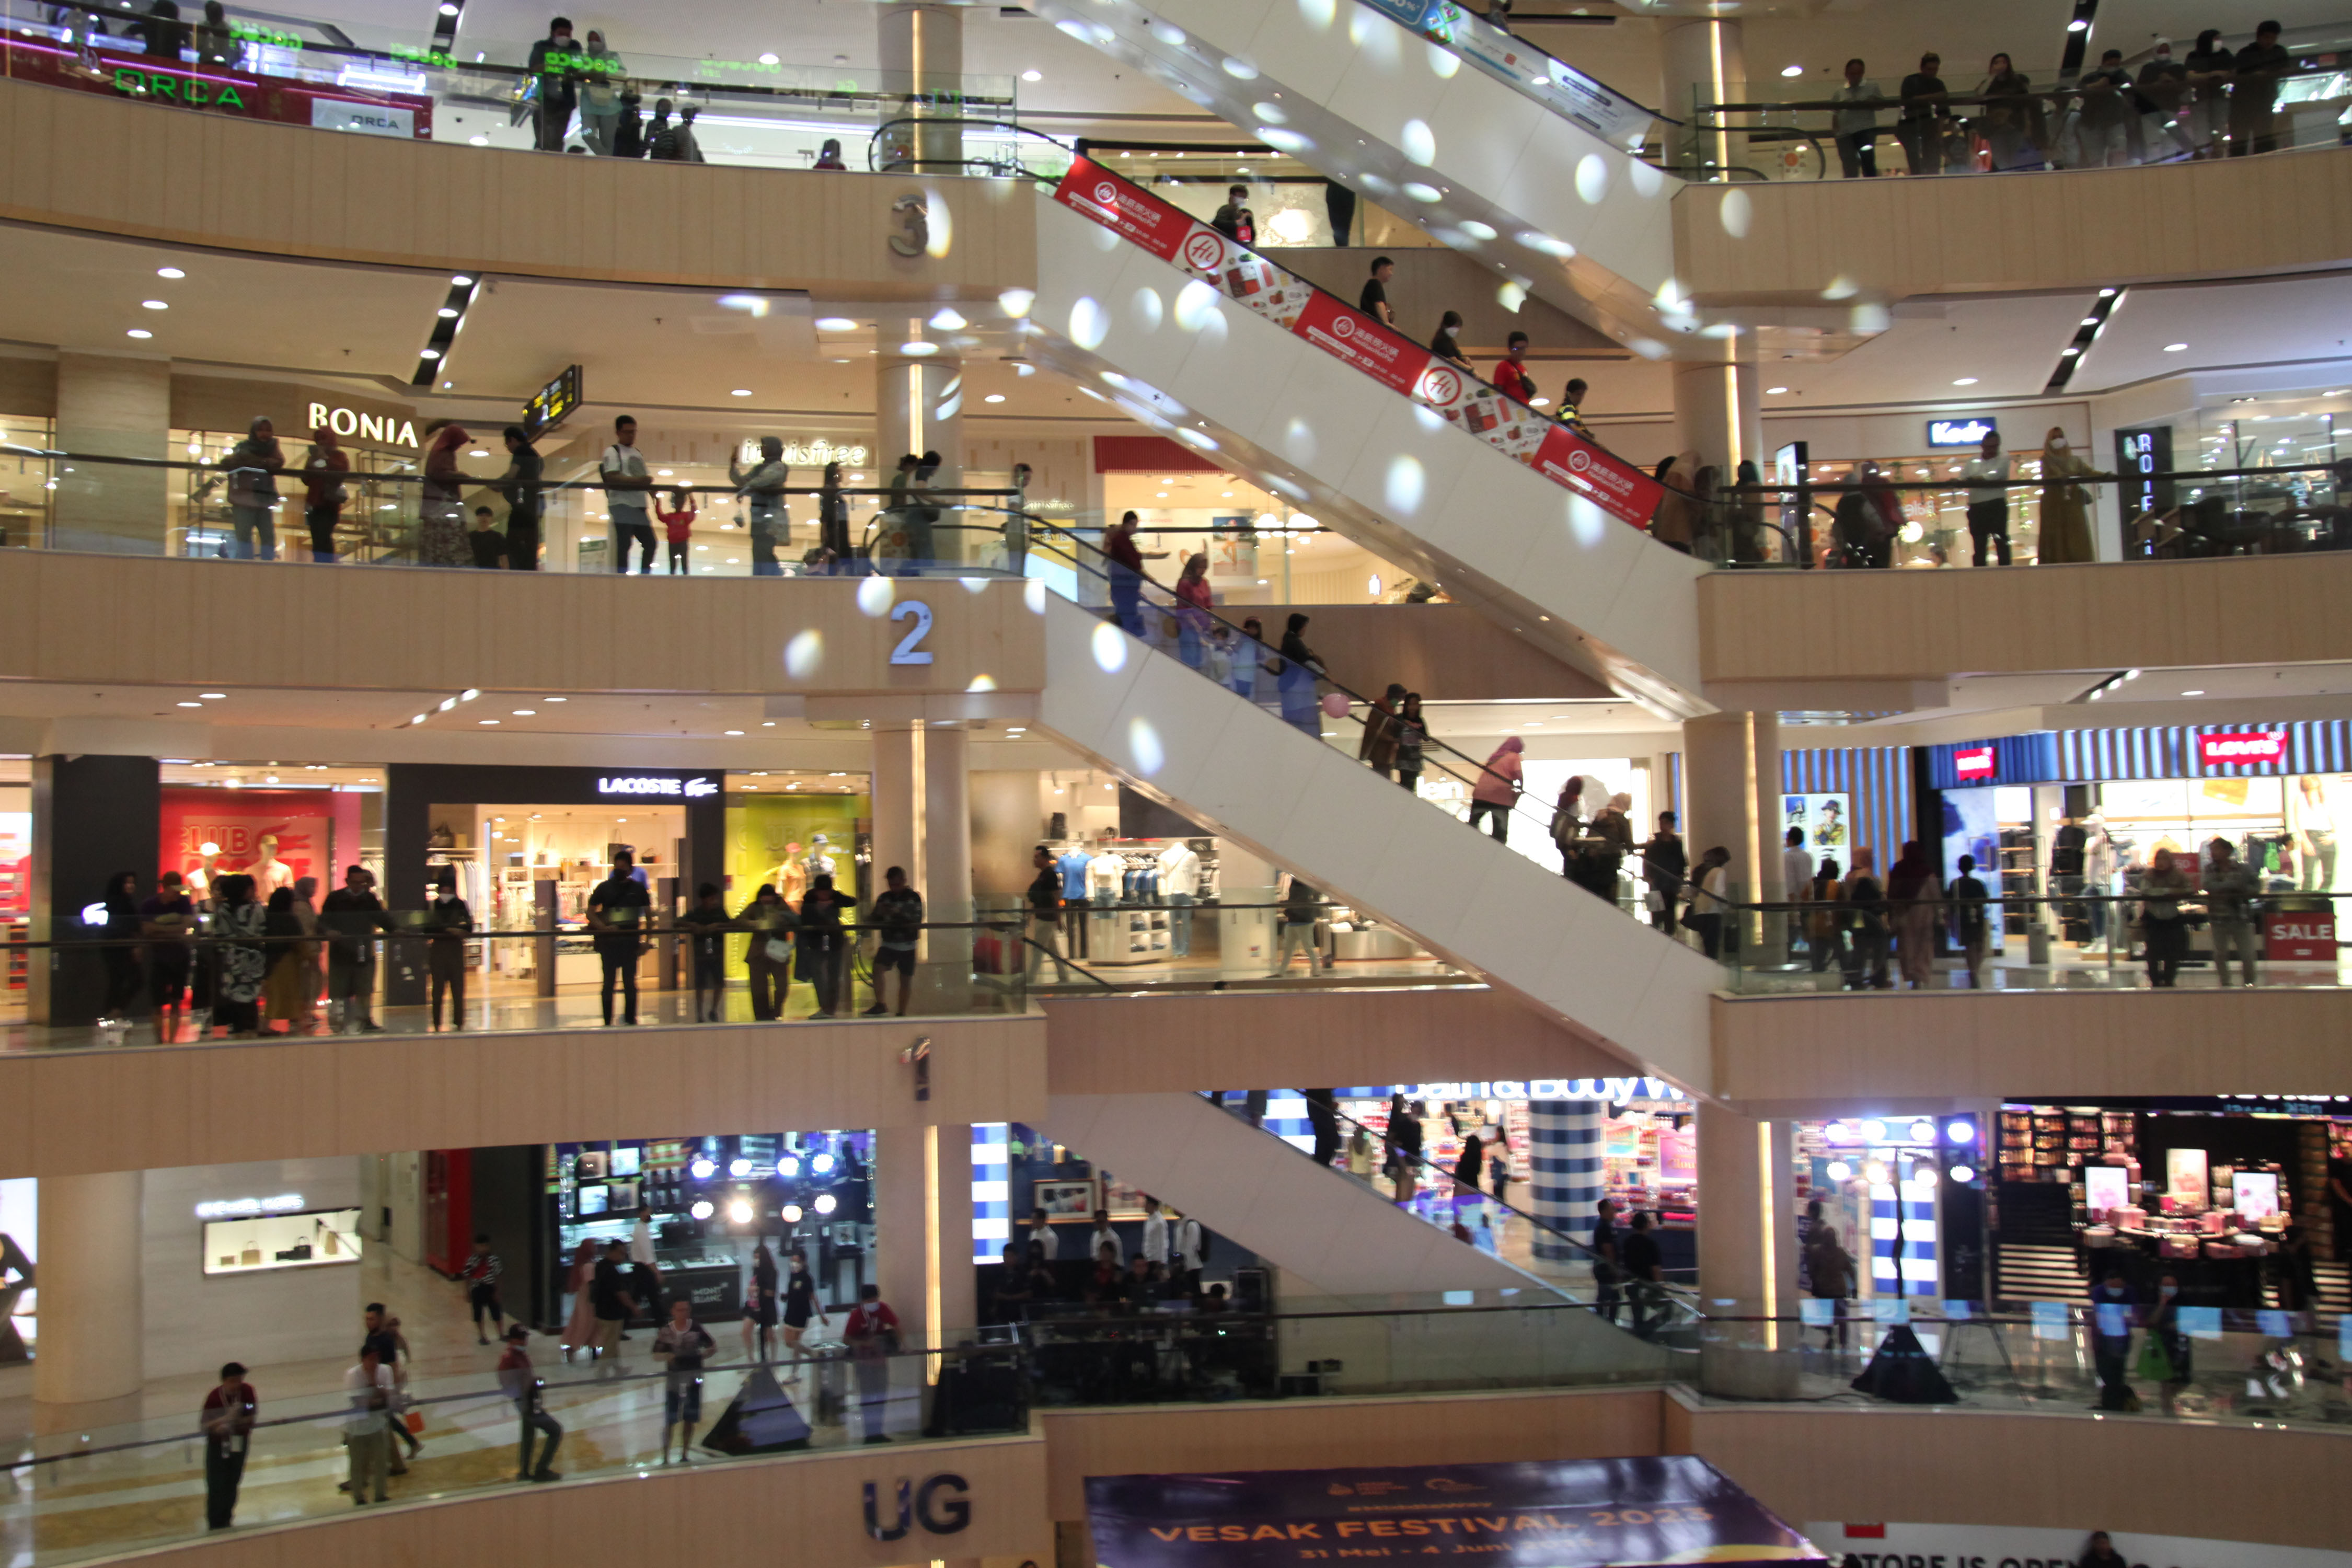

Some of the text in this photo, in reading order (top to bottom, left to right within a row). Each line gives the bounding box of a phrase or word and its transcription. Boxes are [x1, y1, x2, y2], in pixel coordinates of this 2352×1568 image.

[115, 68, 244, 108] ORCA
[352, 115, 399, 129] ORCA
[890, 193, 929, 257] 3
[1429, 375, 1455, 398] Hi
[309, 402, 419, 448] BONIA
[742, 439, 866, 464] iisfree
[889, 600, 933, 665] 2
[598, 777, 682, 794] LACOSTE
[2272, 924, 2333, 940] SALE
[863, 1471, 971, 1542] UG
[1149, 1507, 1714, 1542] VESAK FESTIVAL 2023
